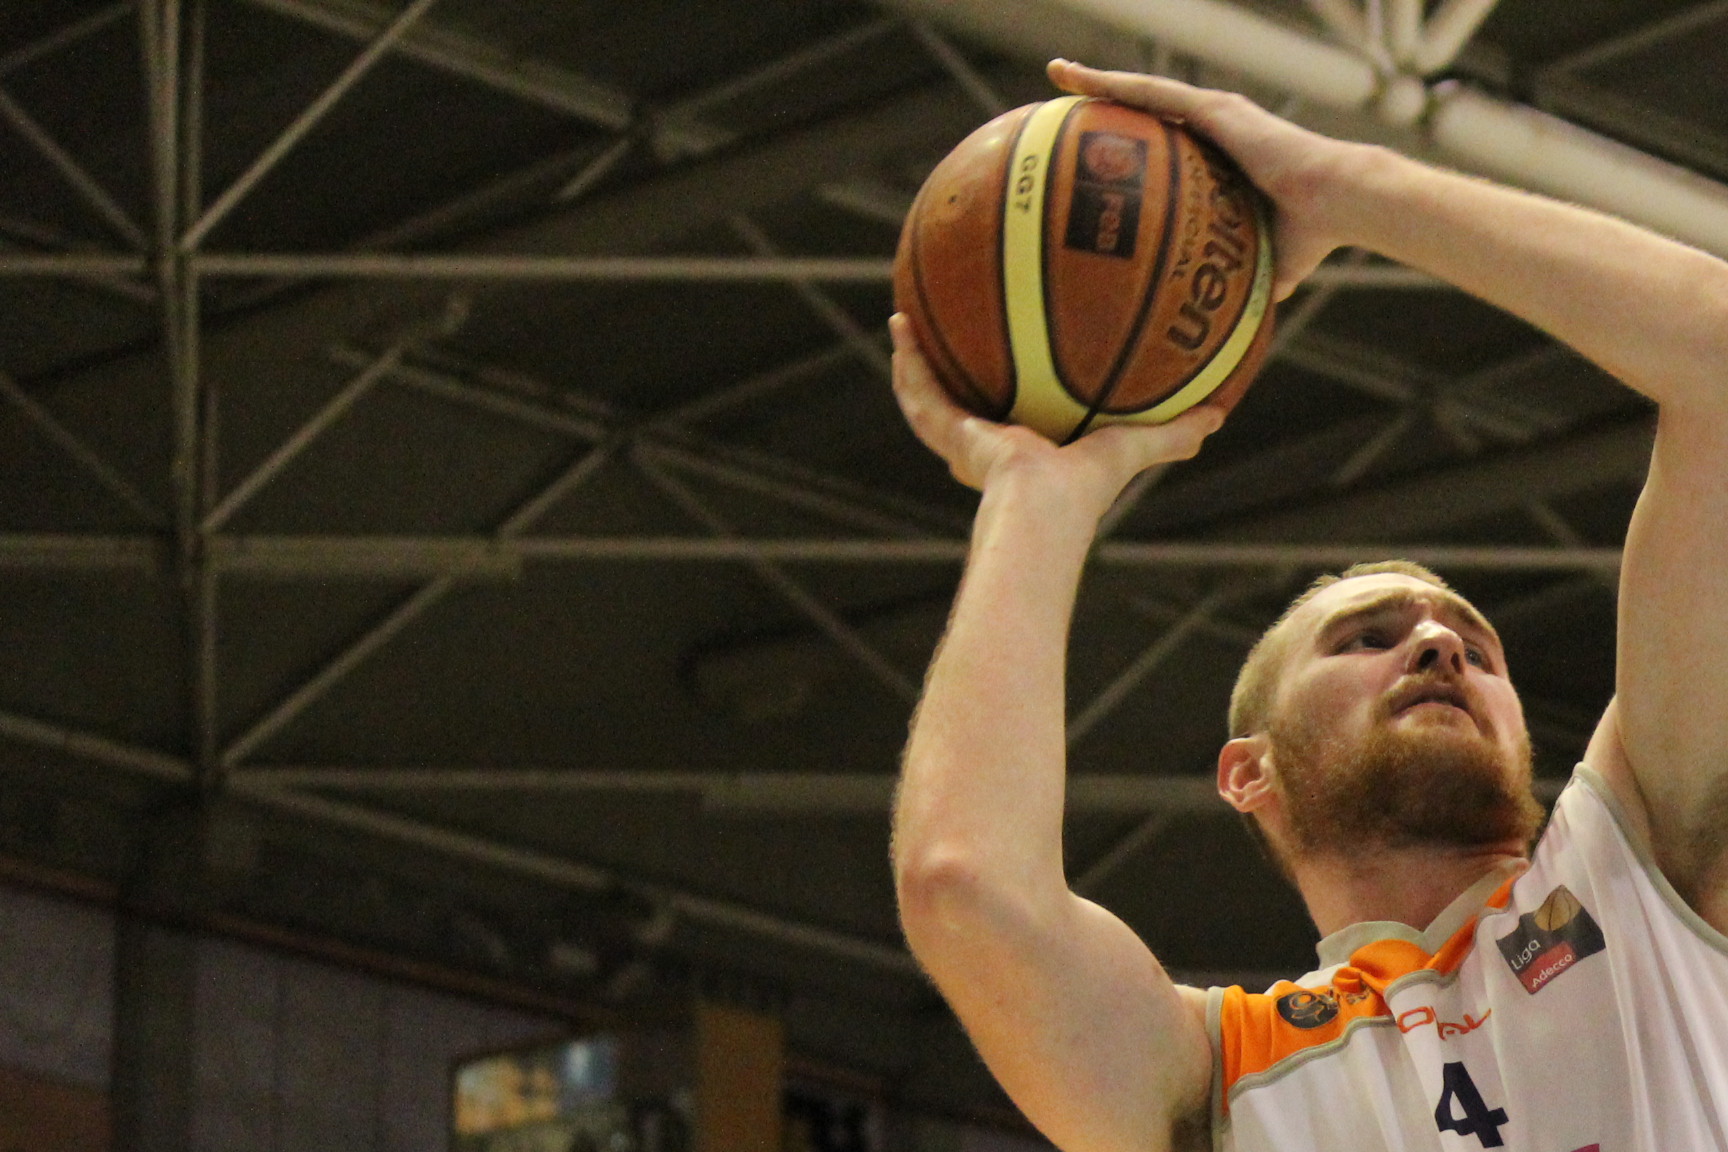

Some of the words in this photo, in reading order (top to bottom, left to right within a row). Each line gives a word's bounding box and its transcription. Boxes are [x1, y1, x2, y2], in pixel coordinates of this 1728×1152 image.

[1510, 939, 1541, 971] Liga
[1531, 953, 1573, 989] Adecco
[1434, 1061, 1509, 1149] 4
